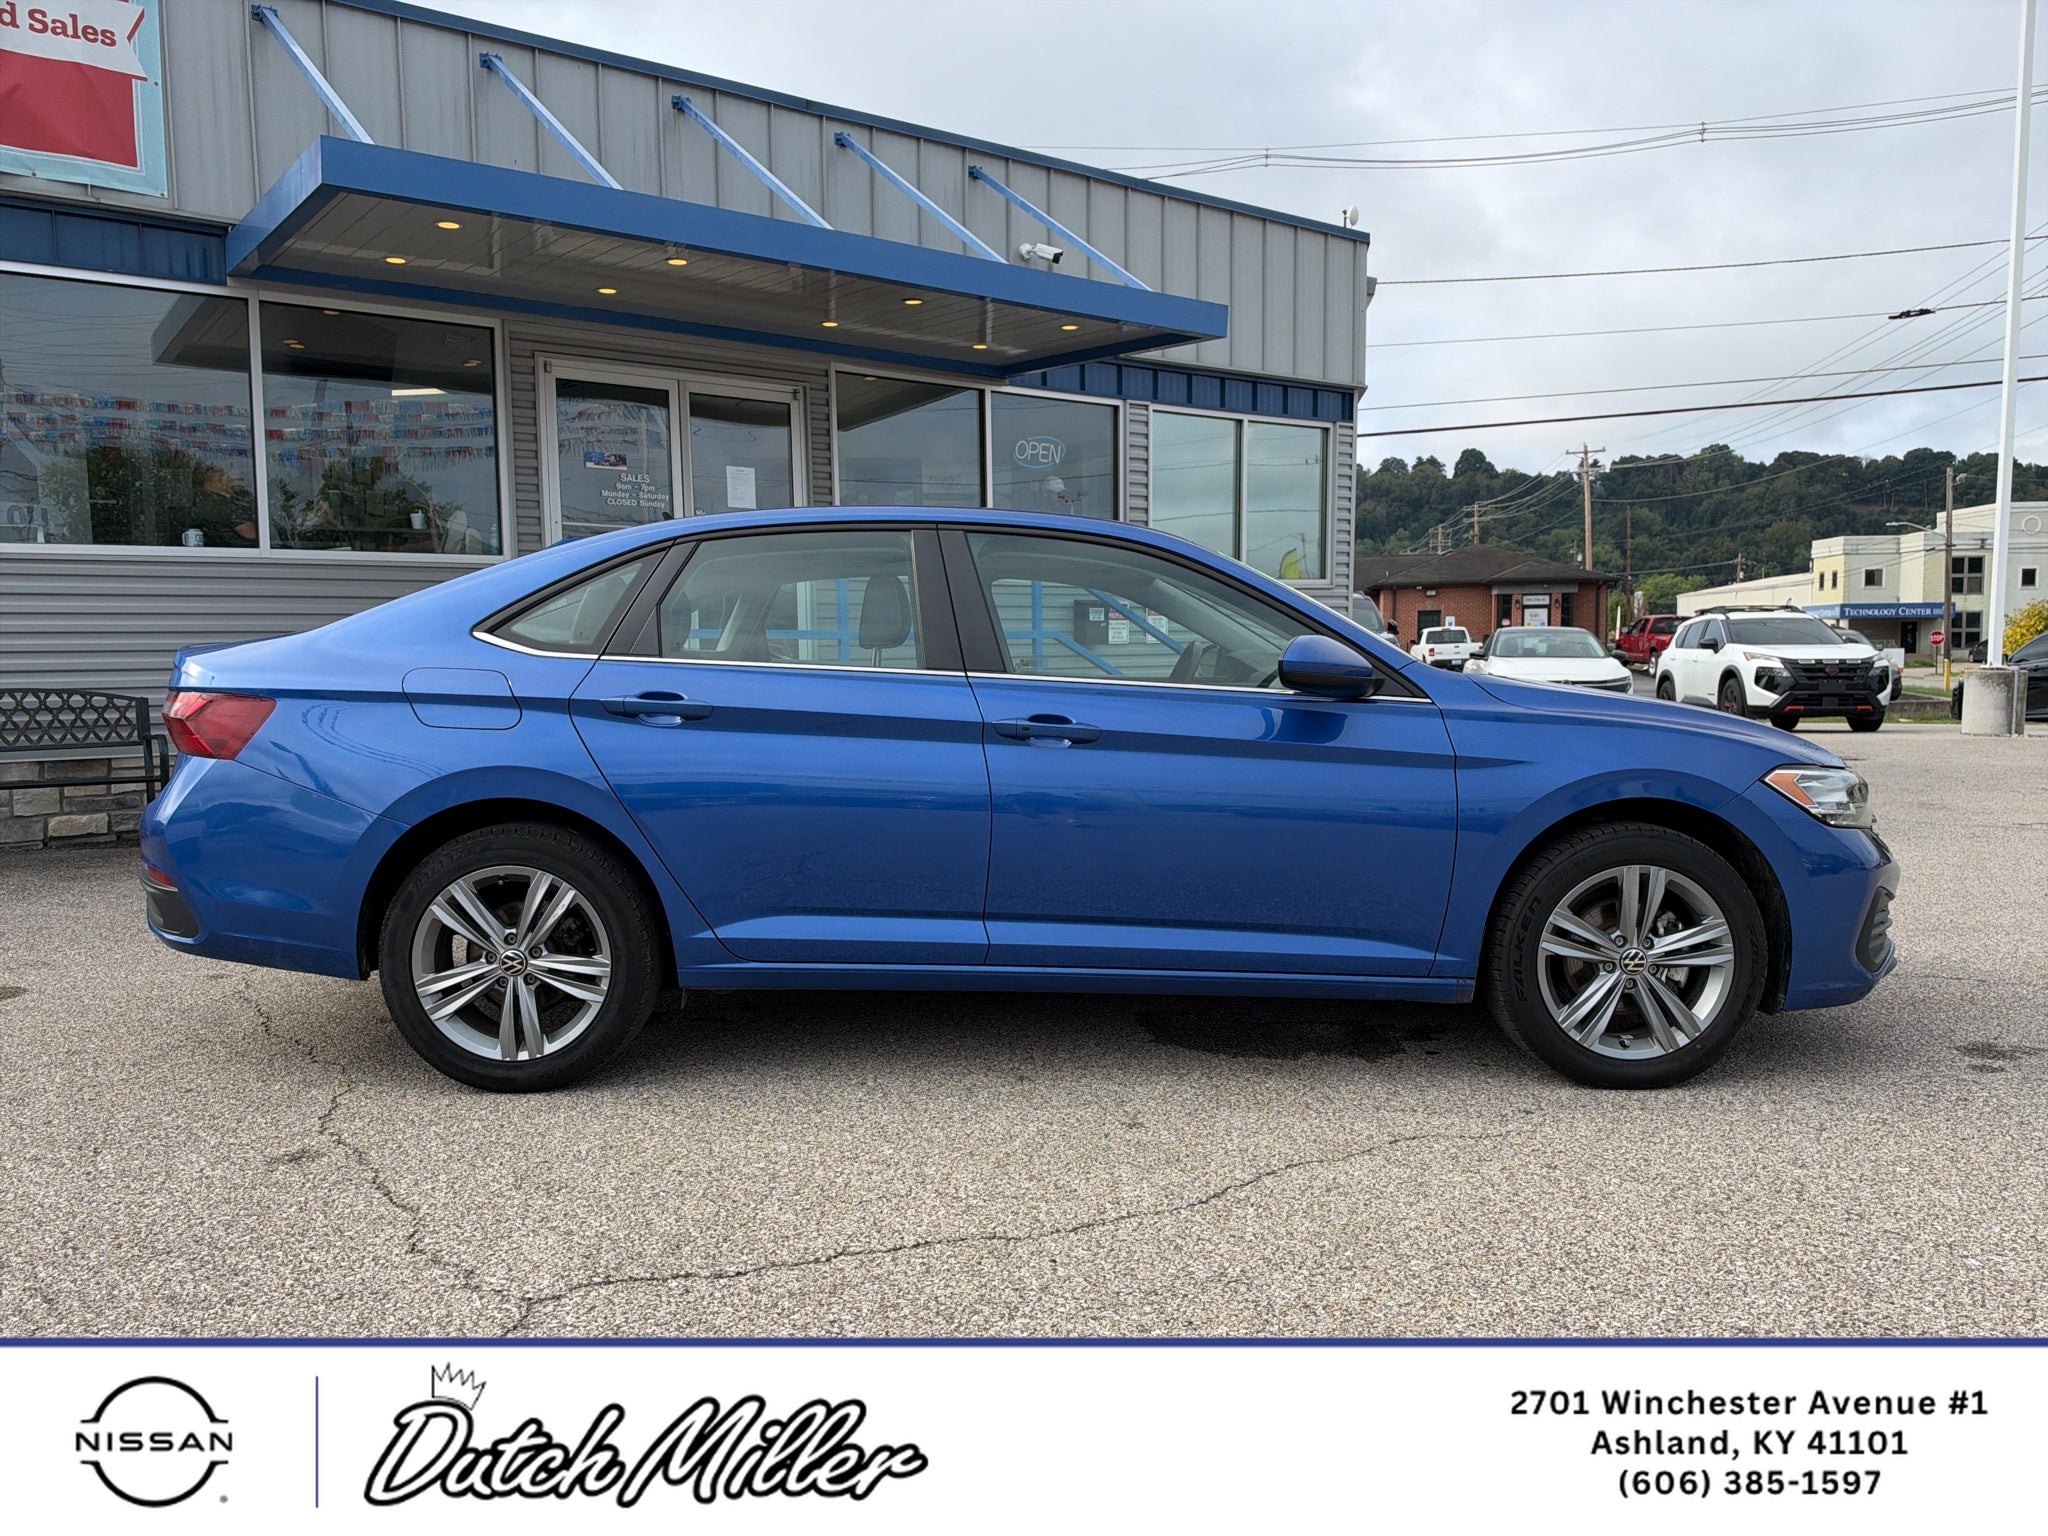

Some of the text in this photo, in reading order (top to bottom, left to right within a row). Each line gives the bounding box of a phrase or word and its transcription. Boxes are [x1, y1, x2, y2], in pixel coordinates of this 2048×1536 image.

[27, 8, 117, 47] Sales
[1015, 440, 1061, 464] OPEN
[620, 473, 650, 483] SALES
[616, 482, 632, 490] 9am
[641, 484, 656, 492] 7pm
[601, 490, 630, 498] Monday
[638, 492, 669, 501] Saturday
[607, 498, 665, 509] CLOSED Sunday
[1843, 607, 1896, 617] TECHNOLOGY
[1898, 606, 1932, 616] CENTER
[1929, 634, 1944, 643] STOP
[1513, 896, 1542, 1001] FALKEN
